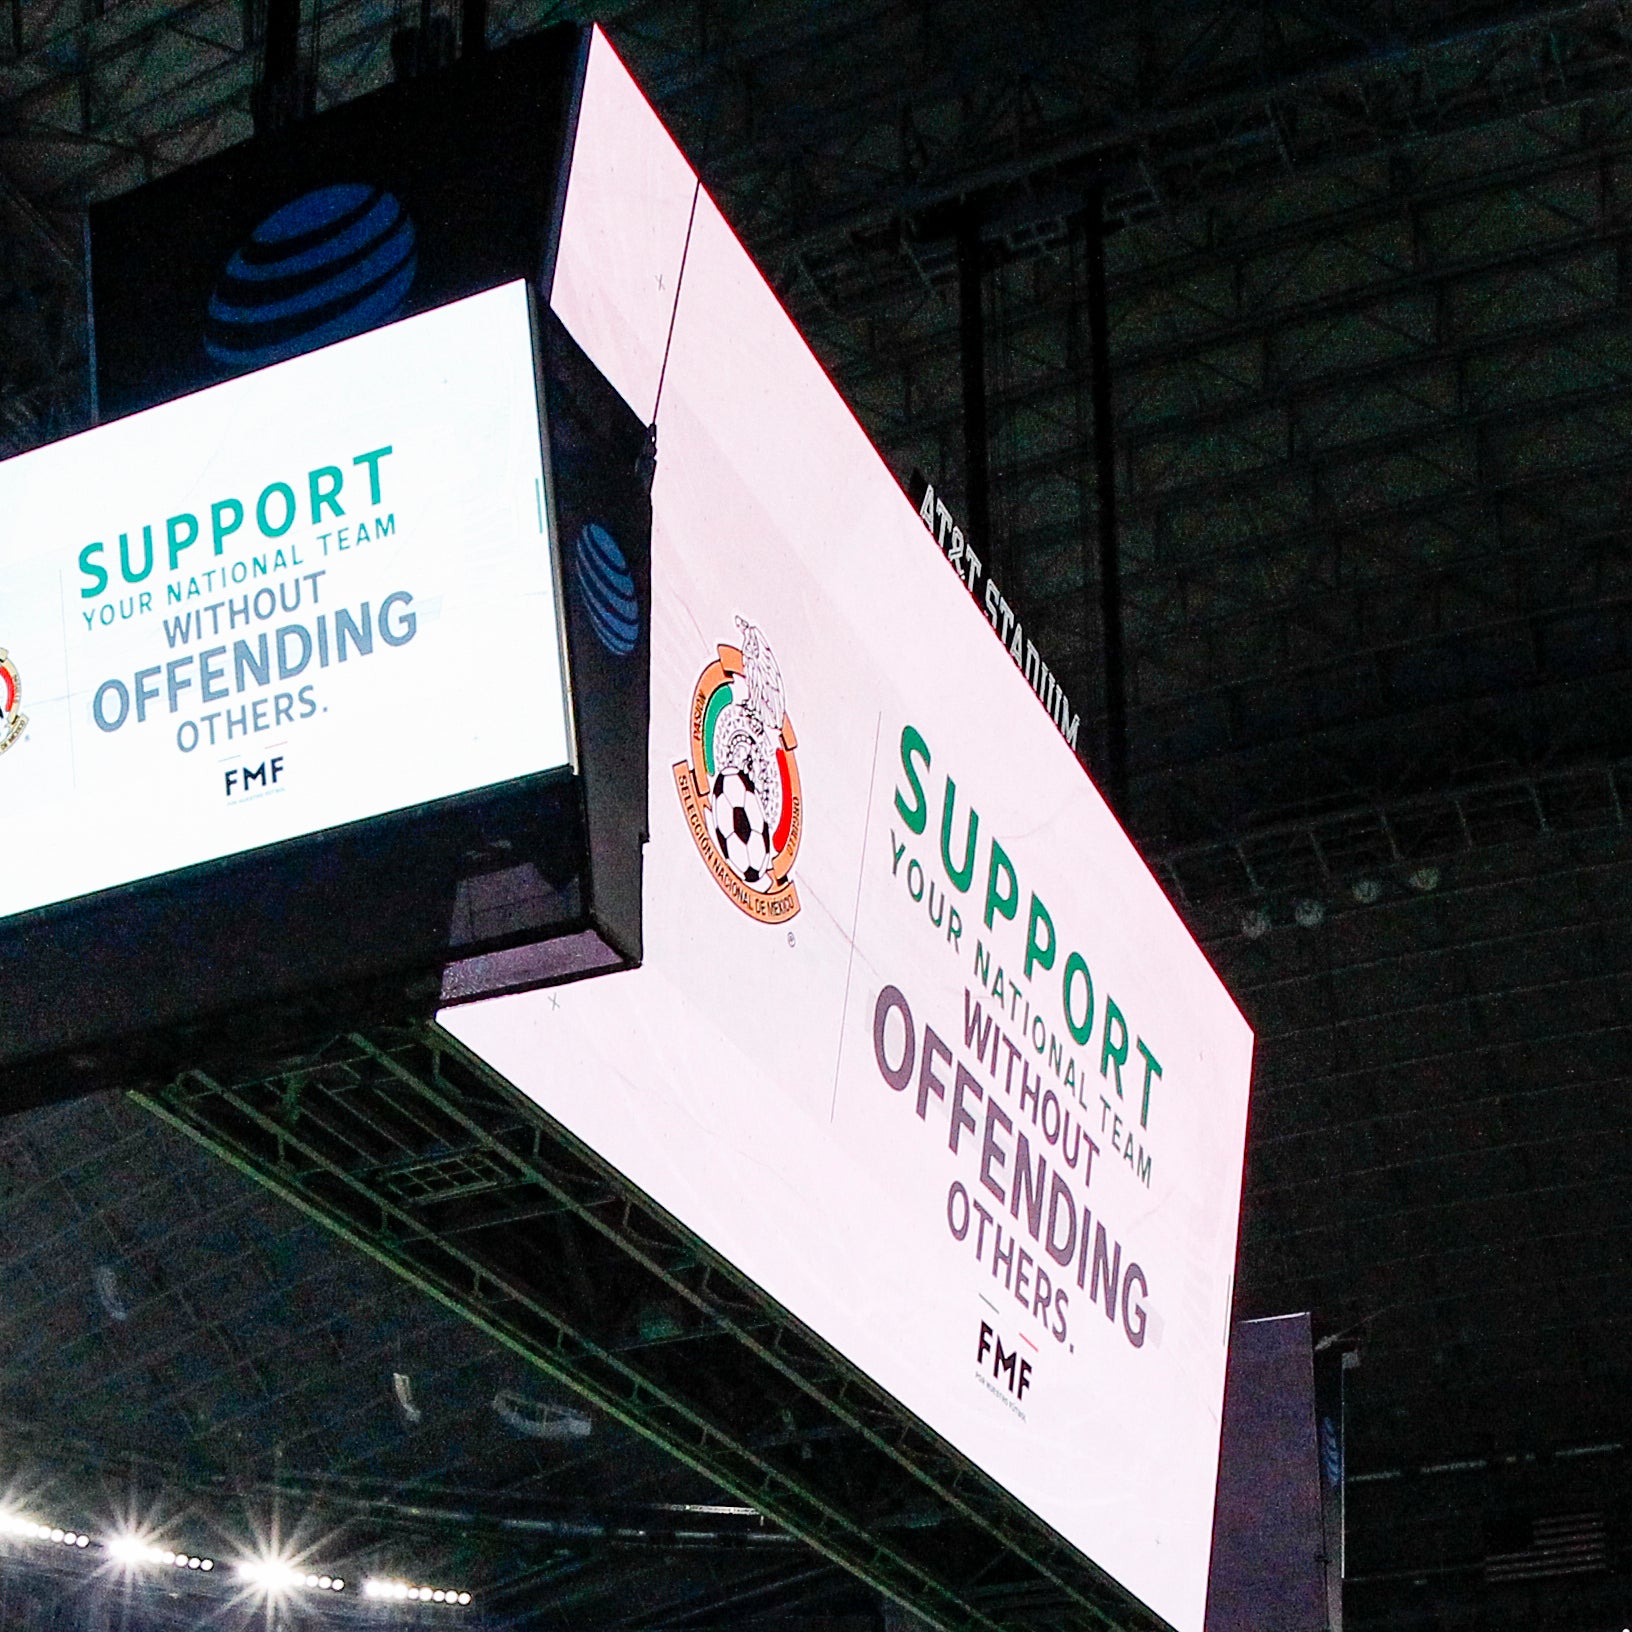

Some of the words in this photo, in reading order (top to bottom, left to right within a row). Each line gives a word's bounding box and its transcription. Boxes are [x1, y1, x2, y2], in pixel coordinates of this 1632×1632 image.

[78, 445, 393, 599] SUPPORT
[83, 592, 153, 631] YOUR
[167, 545, 304, 605] NATIONAL
[317, 513, 396, 556] TEAM
[920, 484, 982, 591] AT&T
[93, 590, 418, 732] OFFENDING
[163, 570, 326, 648] WITHOUT
[176, 685, 329, 752] OTHERS.
[225, 756, 285, 796] FMF
[678, 774, 713, 862] SELECCIÓN
[713, 858, 755, 912] NACIONAL
[754, 898, 767, 916] DE
[894, 725, 1163, 1131] SUPPORT
[890, 829, 963, 953] YOUR
[974, 939, 1088, 1112] NATIONAL
[1100, 1094, 1152, 1189] TEAM
[963, 987, 1100, 1188] WITHOUT
[873, 985, 1148, 1349] OFFENDING
[947, 1181, 1074, 1354] OTHERS.
[977, 1320, 1032, 1400] FMF
